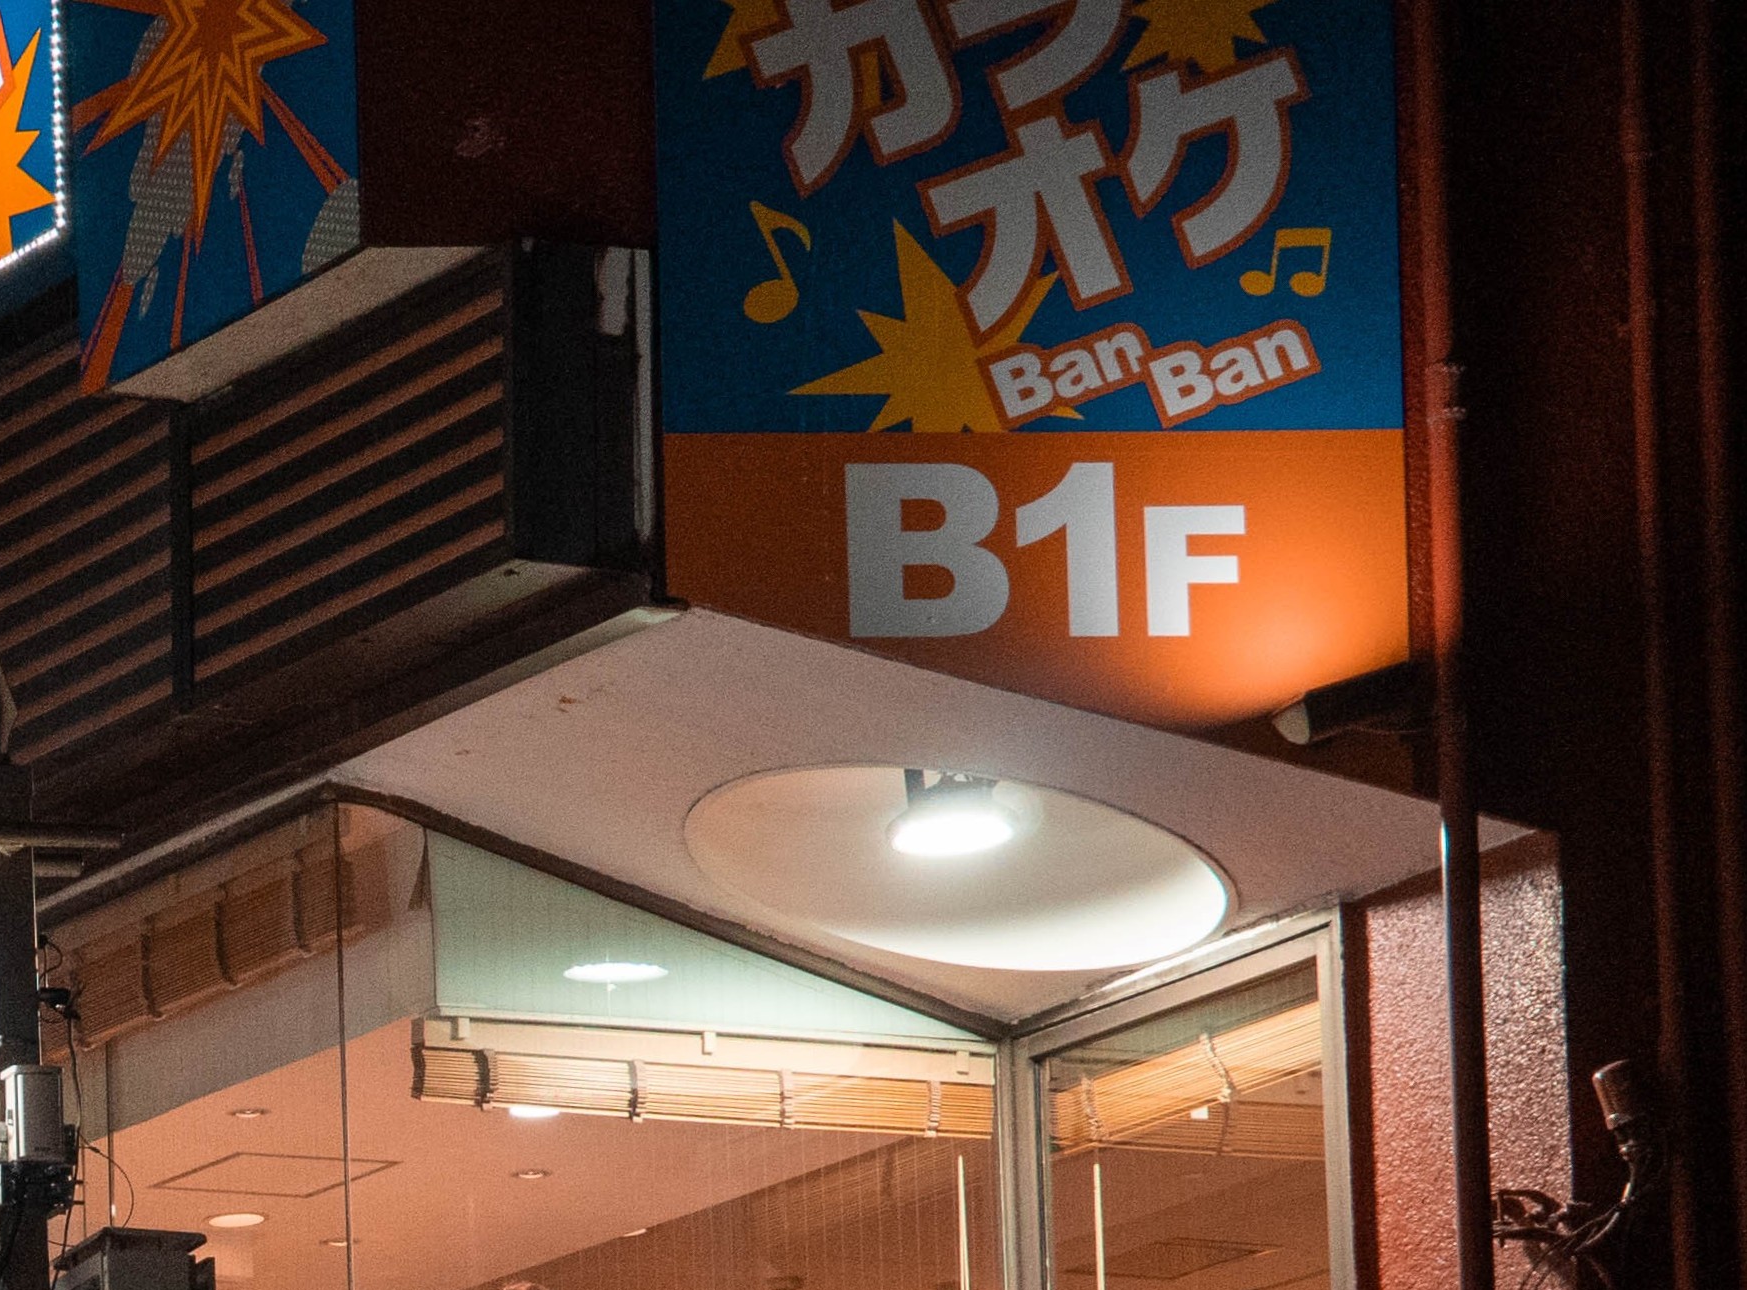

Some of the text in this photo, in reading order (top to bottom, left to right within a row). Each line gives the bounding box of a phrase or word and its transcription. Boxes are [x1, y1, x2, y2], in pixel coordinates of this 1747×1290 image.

[983, 326, 1145, 426] Ban
[1145, 322, 1317, 424] Ban
[843, 461, 1247, 640] B1F
